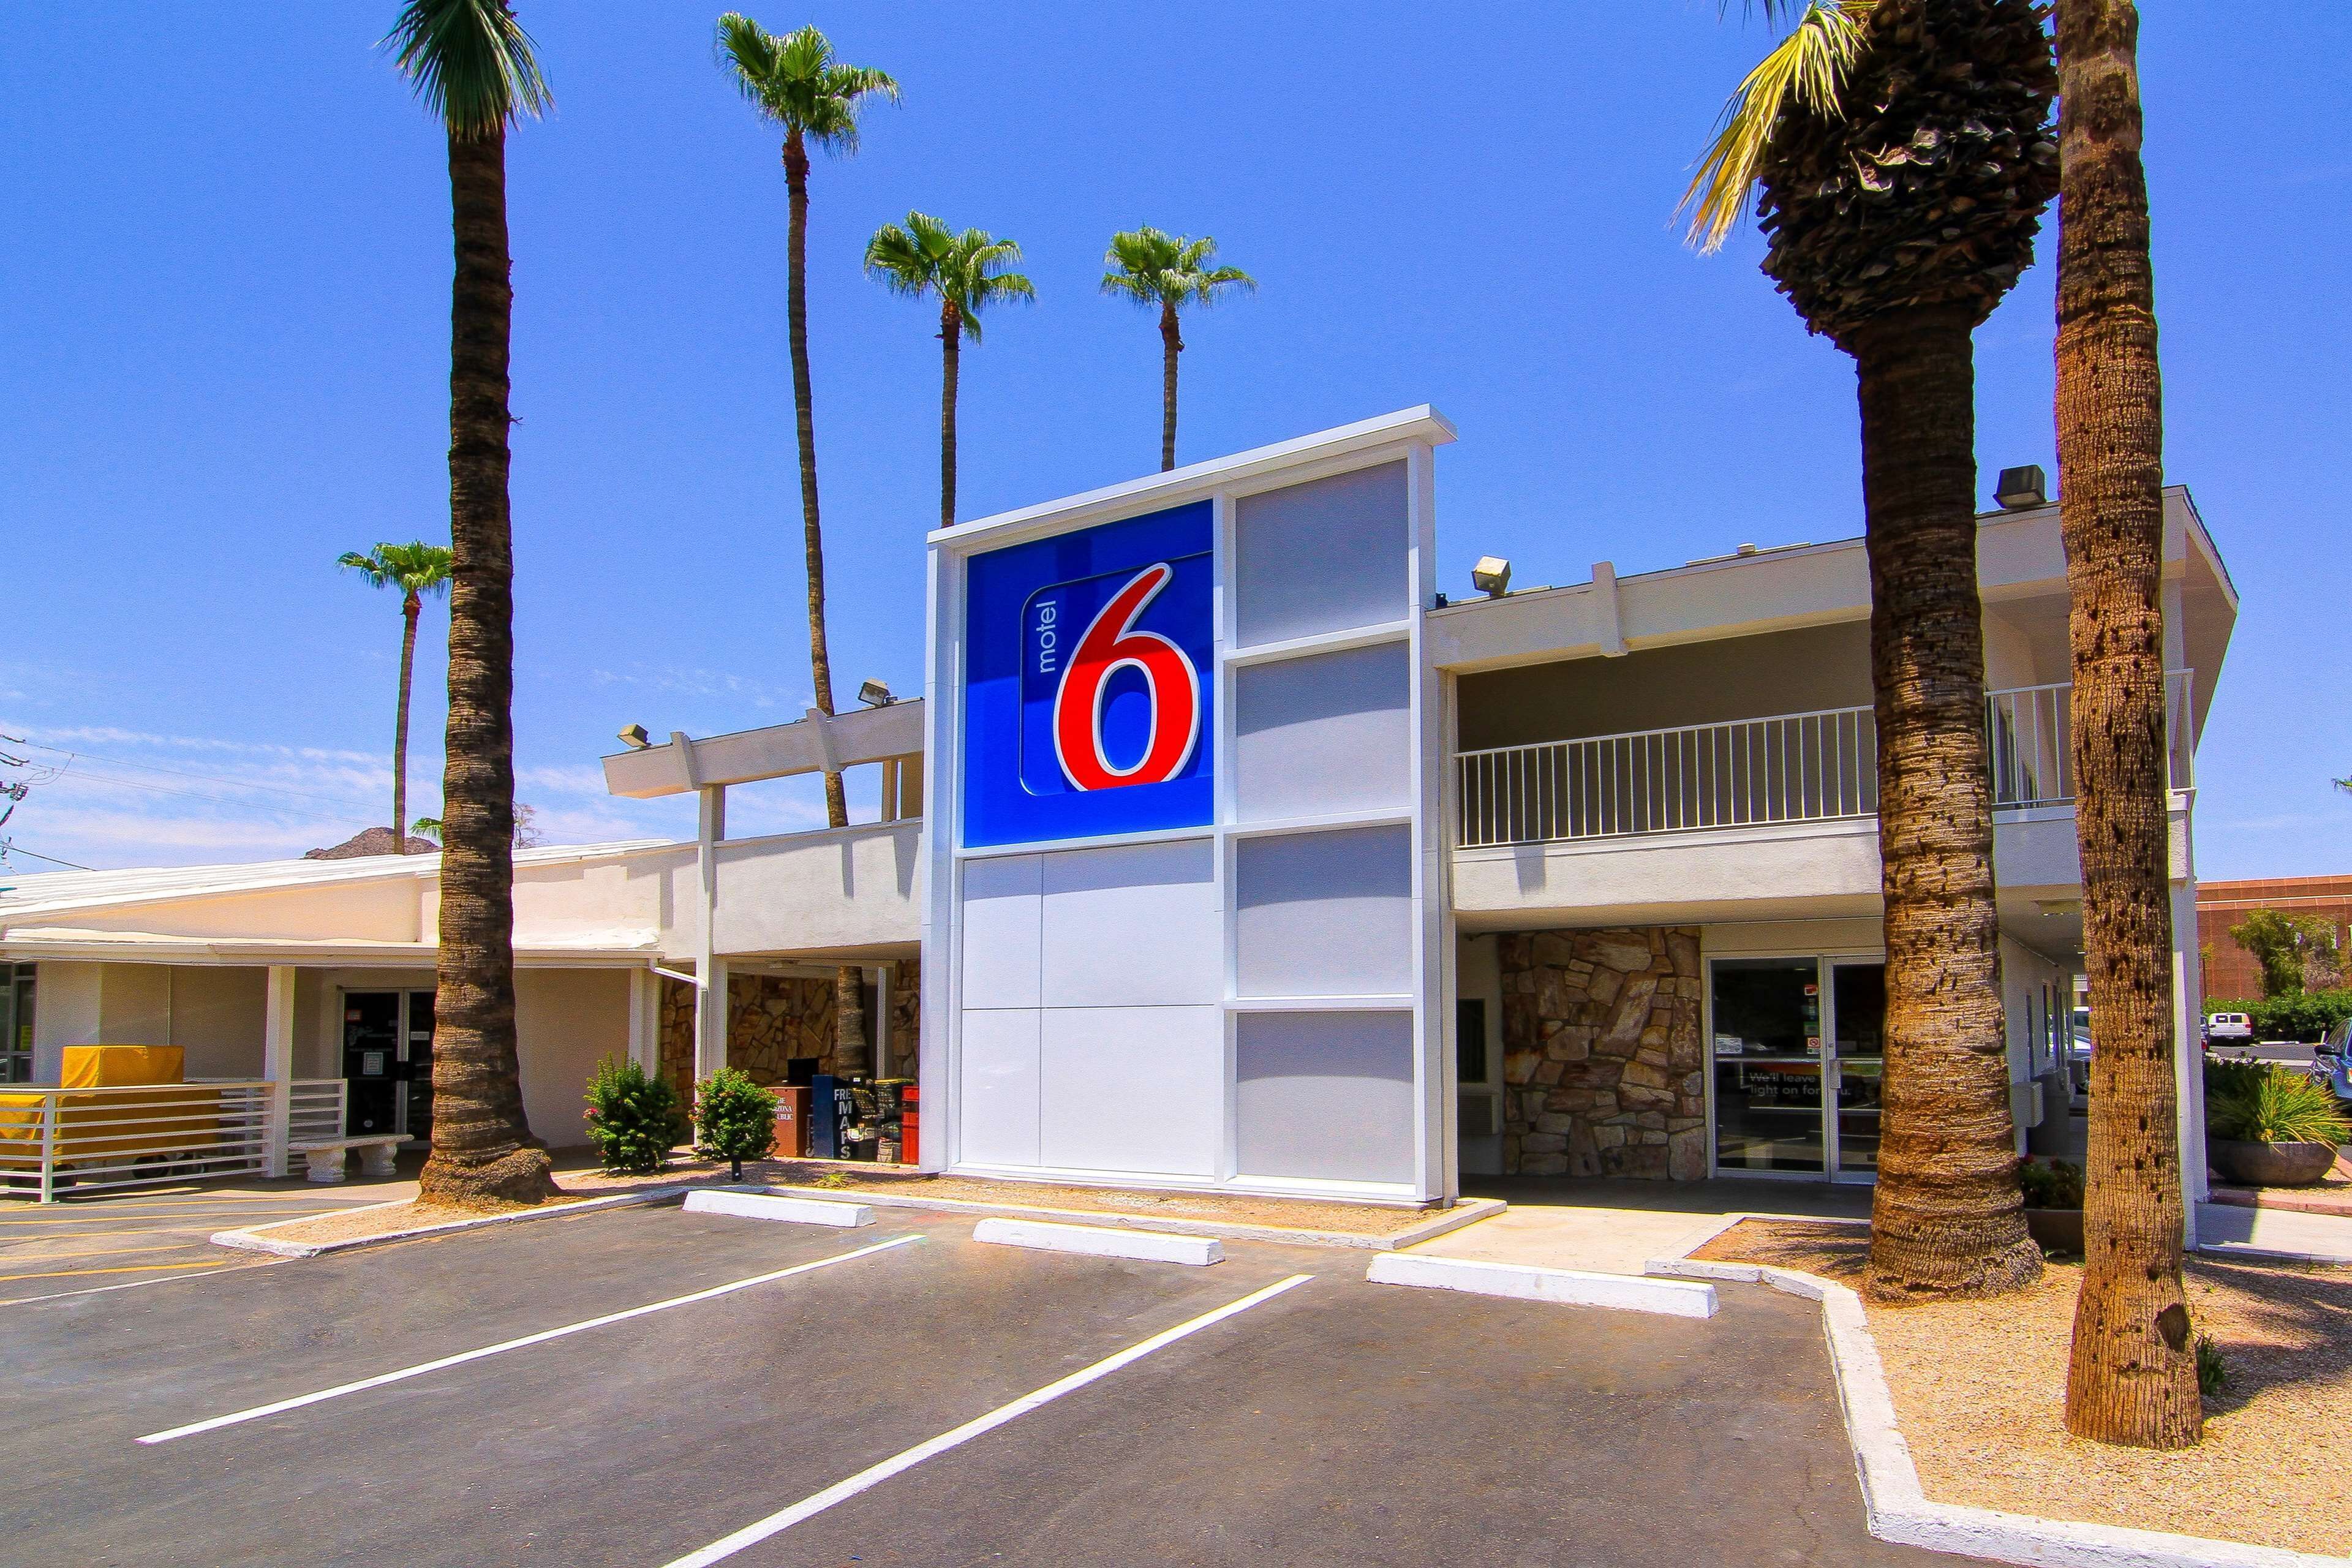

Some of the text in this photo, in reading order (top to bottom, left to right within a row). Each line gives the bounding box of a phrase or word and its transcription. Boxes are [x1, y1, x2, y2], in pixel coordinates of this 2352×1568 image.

[1036, 562, 1202, 791] motel 6
[1749, 1072, 1815, 1083] We'll leave
[834, 1088, 852, 1101] FRE
[1750, 1084, 1779, 1097] light
[1782, 1087, 1798, 1095] on
[1803, 1085, 1820, 1095] for
